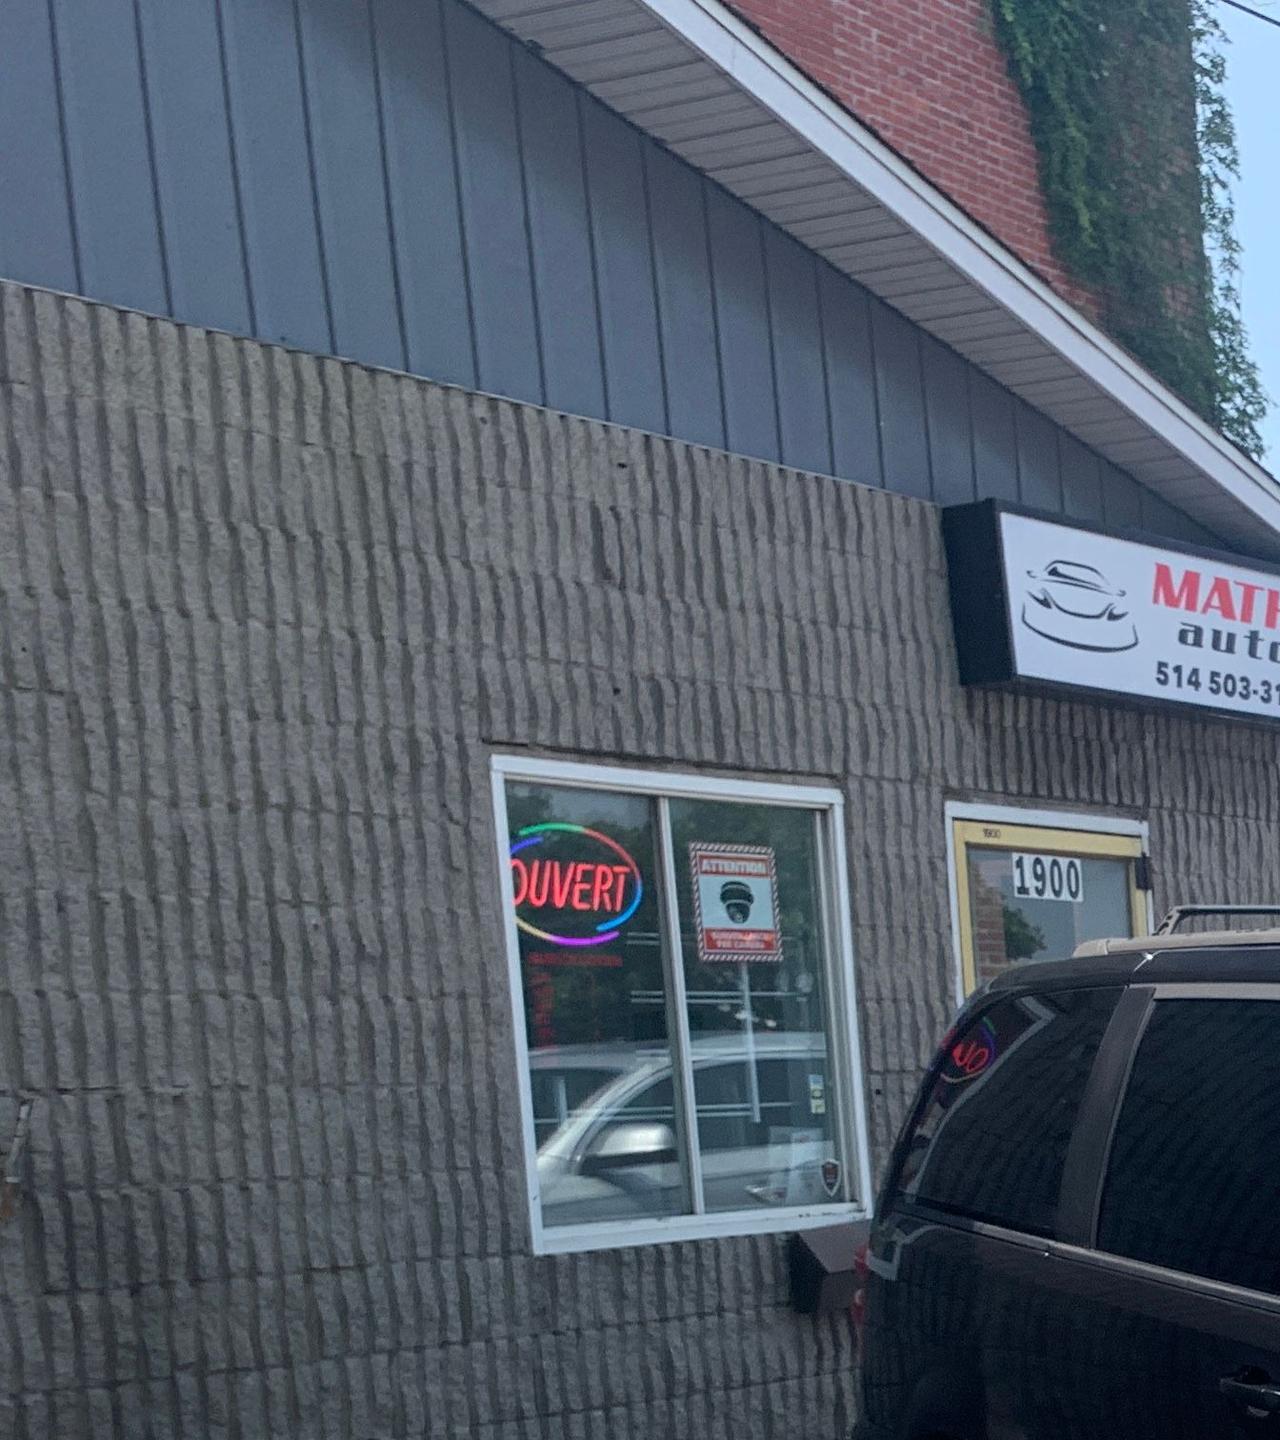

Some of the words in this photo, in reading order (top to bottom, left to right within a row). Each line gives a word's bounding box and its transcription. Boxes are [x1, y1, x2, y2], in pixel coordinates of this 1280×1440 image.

[1155, 661, 1202, 692] 514
[511, 858, 630, 912] OUVERT
[1014, 855, 1081, 900] 1900
